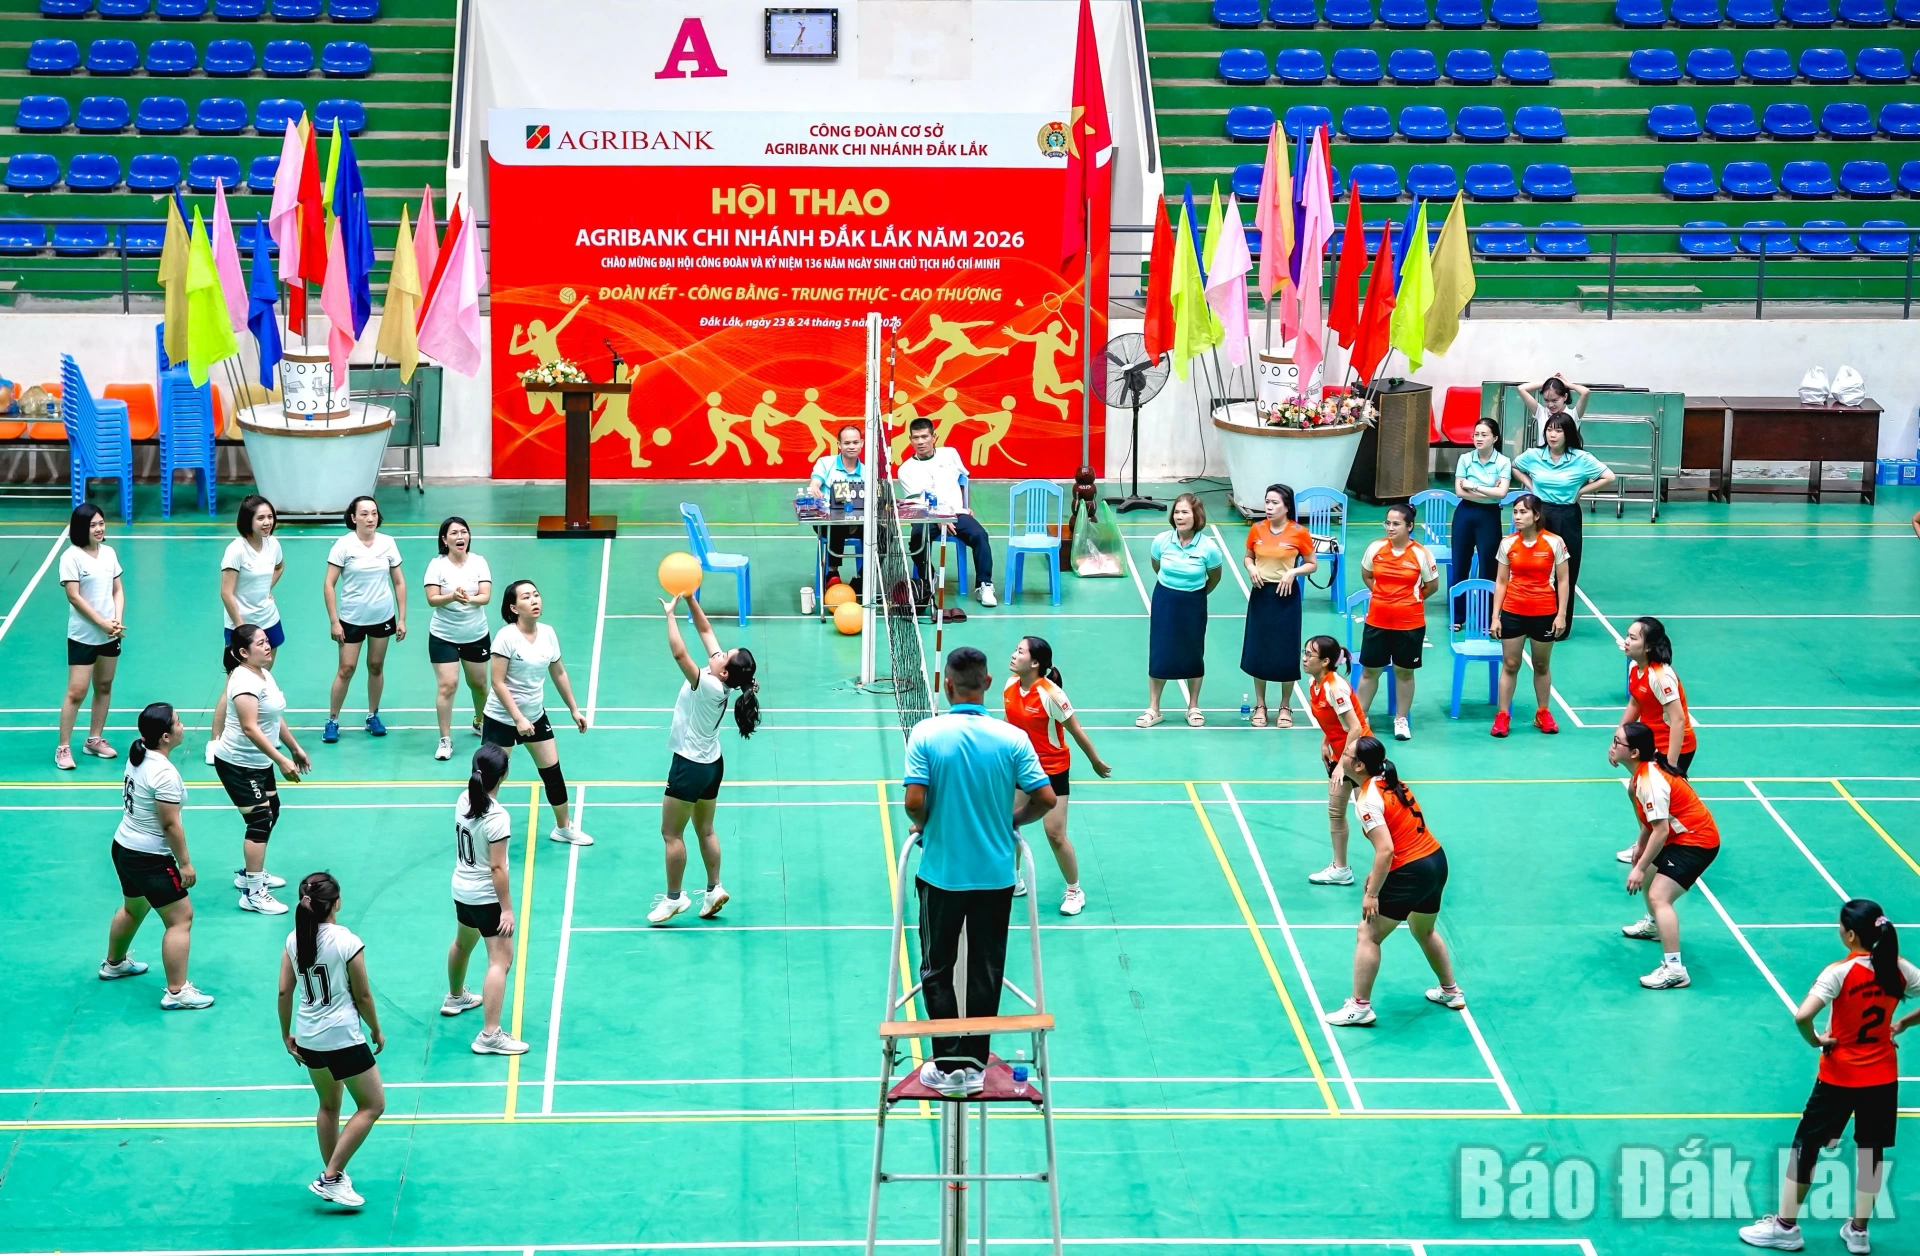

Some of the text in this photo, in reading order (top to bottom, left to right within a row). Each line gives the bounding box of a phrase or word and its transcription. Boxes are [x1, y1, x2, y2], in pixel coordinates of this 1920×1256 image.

[655, 17, 727, 79] A
[557, 130, 715, 150] AGRIBANK
[809, 122, 944, 138] CÔNG ĐOÀN CƠ SỞ
[764, 140, 988, 156] AGRIBANK CHI NHÁNH ĐẮK LẮK
[712, 183, 890, 219] HỘI THAO
[575, 224, 1025, 248] AGRIBANK CHI NHÁNH ĐẮK LẮK NĂM 2026
[601, 256, 626, 268] CHÀO
[628, 256, 657, 268] MỪNG
[659, 257, 675, 270] ĐẠI
[677, 256, 694, 270] HỘI
[696, 256, 721, 268] CÔNG
[723, 256, 749, 268] ĐOÀN
[751, 256, 763, 268] VÀ
[765, 255, 777, 268] KỶ
[778, 256, 802, 271] NIỆM
[805, 258, 822, 269] 136
[824, 257, 845, 269] NĂM
[847, 257, 872, 269] NGÀY
[873, 258, 896, 269] SINH
[898, 256, 917, 269] CHỦ
[919, 258, 940, 272] TỊCH
[957, 256, 973, 269] CHÍ
[974, 258, 1000, 269] MINH
[598, 284, 645, 300] ĐOÀN
[648, 282, 677, 300] KẾT
[687, 284, 733, 300] CÔNG
[735, 282, 779, 300] BẰNG
[791, 287, 844, 301] TRUNG
[847, 286, 890, 305] THỰC
[900, 287, 933, 301] CAO
[936, 286, 1002, 305] THƯỢNG
[700, 315, 721, 327] Đắk
[722, 315, 743, 328] Lắk,
[745, 317, 772, 329] ngày
[773, 317, 786, 327] 23
[787, 317, 796, 327] &
[797, 317, 810, 327] 24
[811, 317, 842, 329] tháng
[843, 317, 851, 327] 5
[852, 317, 868, 327] nă
[834, 483, 850, 499] 23
[456, 822, 476, 867] 10
[297, 963, 332, 1006] 11
[1856, 1005, 1885, 1044] 2
